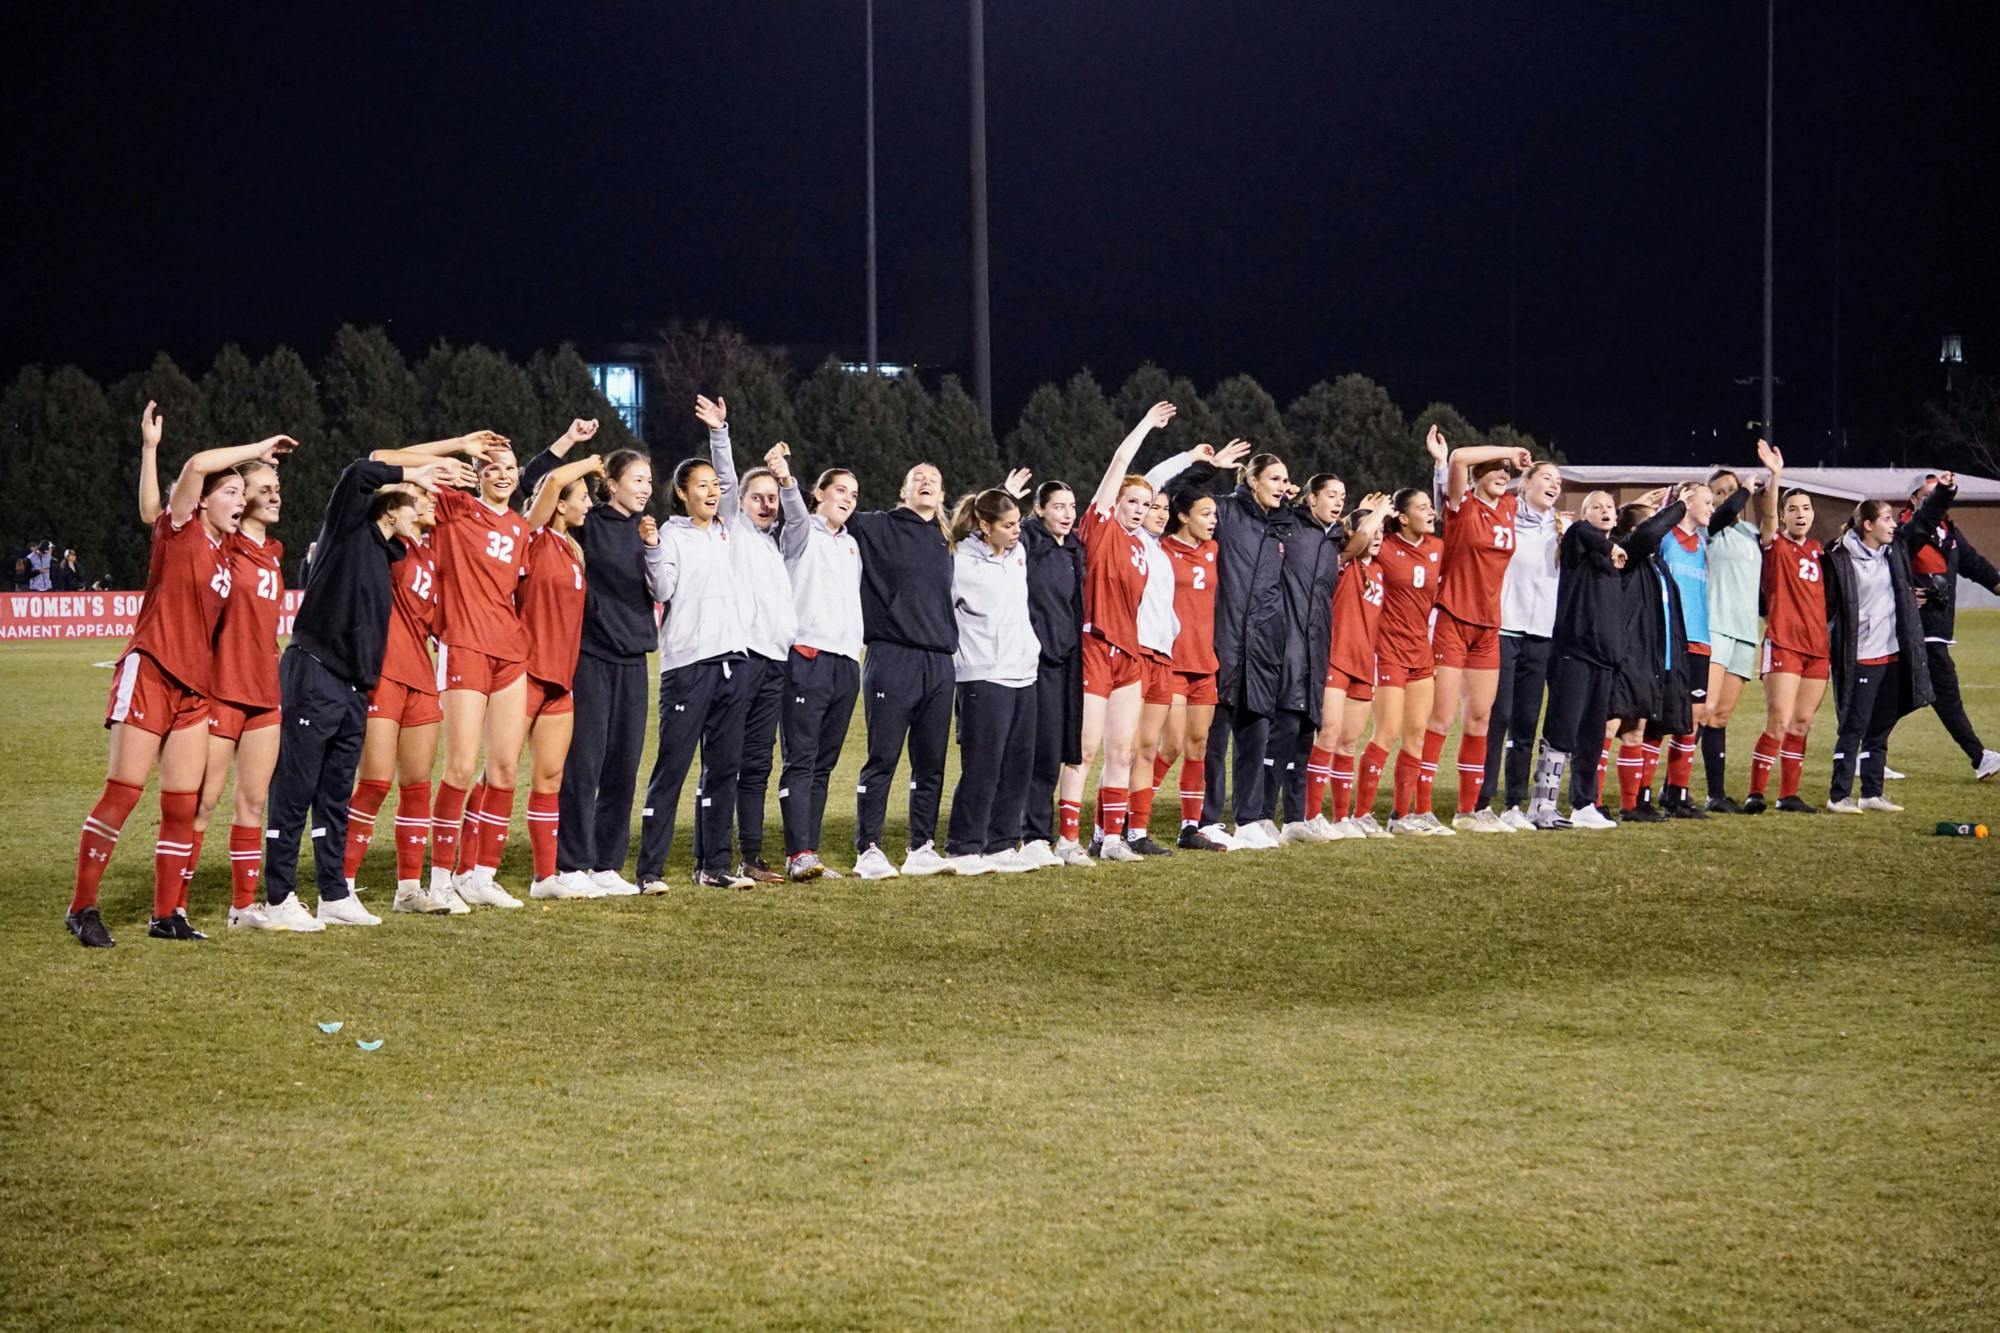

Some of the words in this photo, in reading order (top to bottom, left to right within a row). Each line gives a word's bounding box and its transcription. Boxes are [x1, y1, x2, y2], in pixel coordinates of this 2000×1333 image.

[486, 530, 514, 564] 32
[411, 565, 432, 600] 12
[1192, 566, 1205, 590] 2
[1413, 565, 1425, 588] 8
[1798, 558, 1818, 582] 23
[257, 567, 279, 601] 21
[1363, 580, 1384, 607] 22
[10, 595, 105, 618] WOMEN'S
